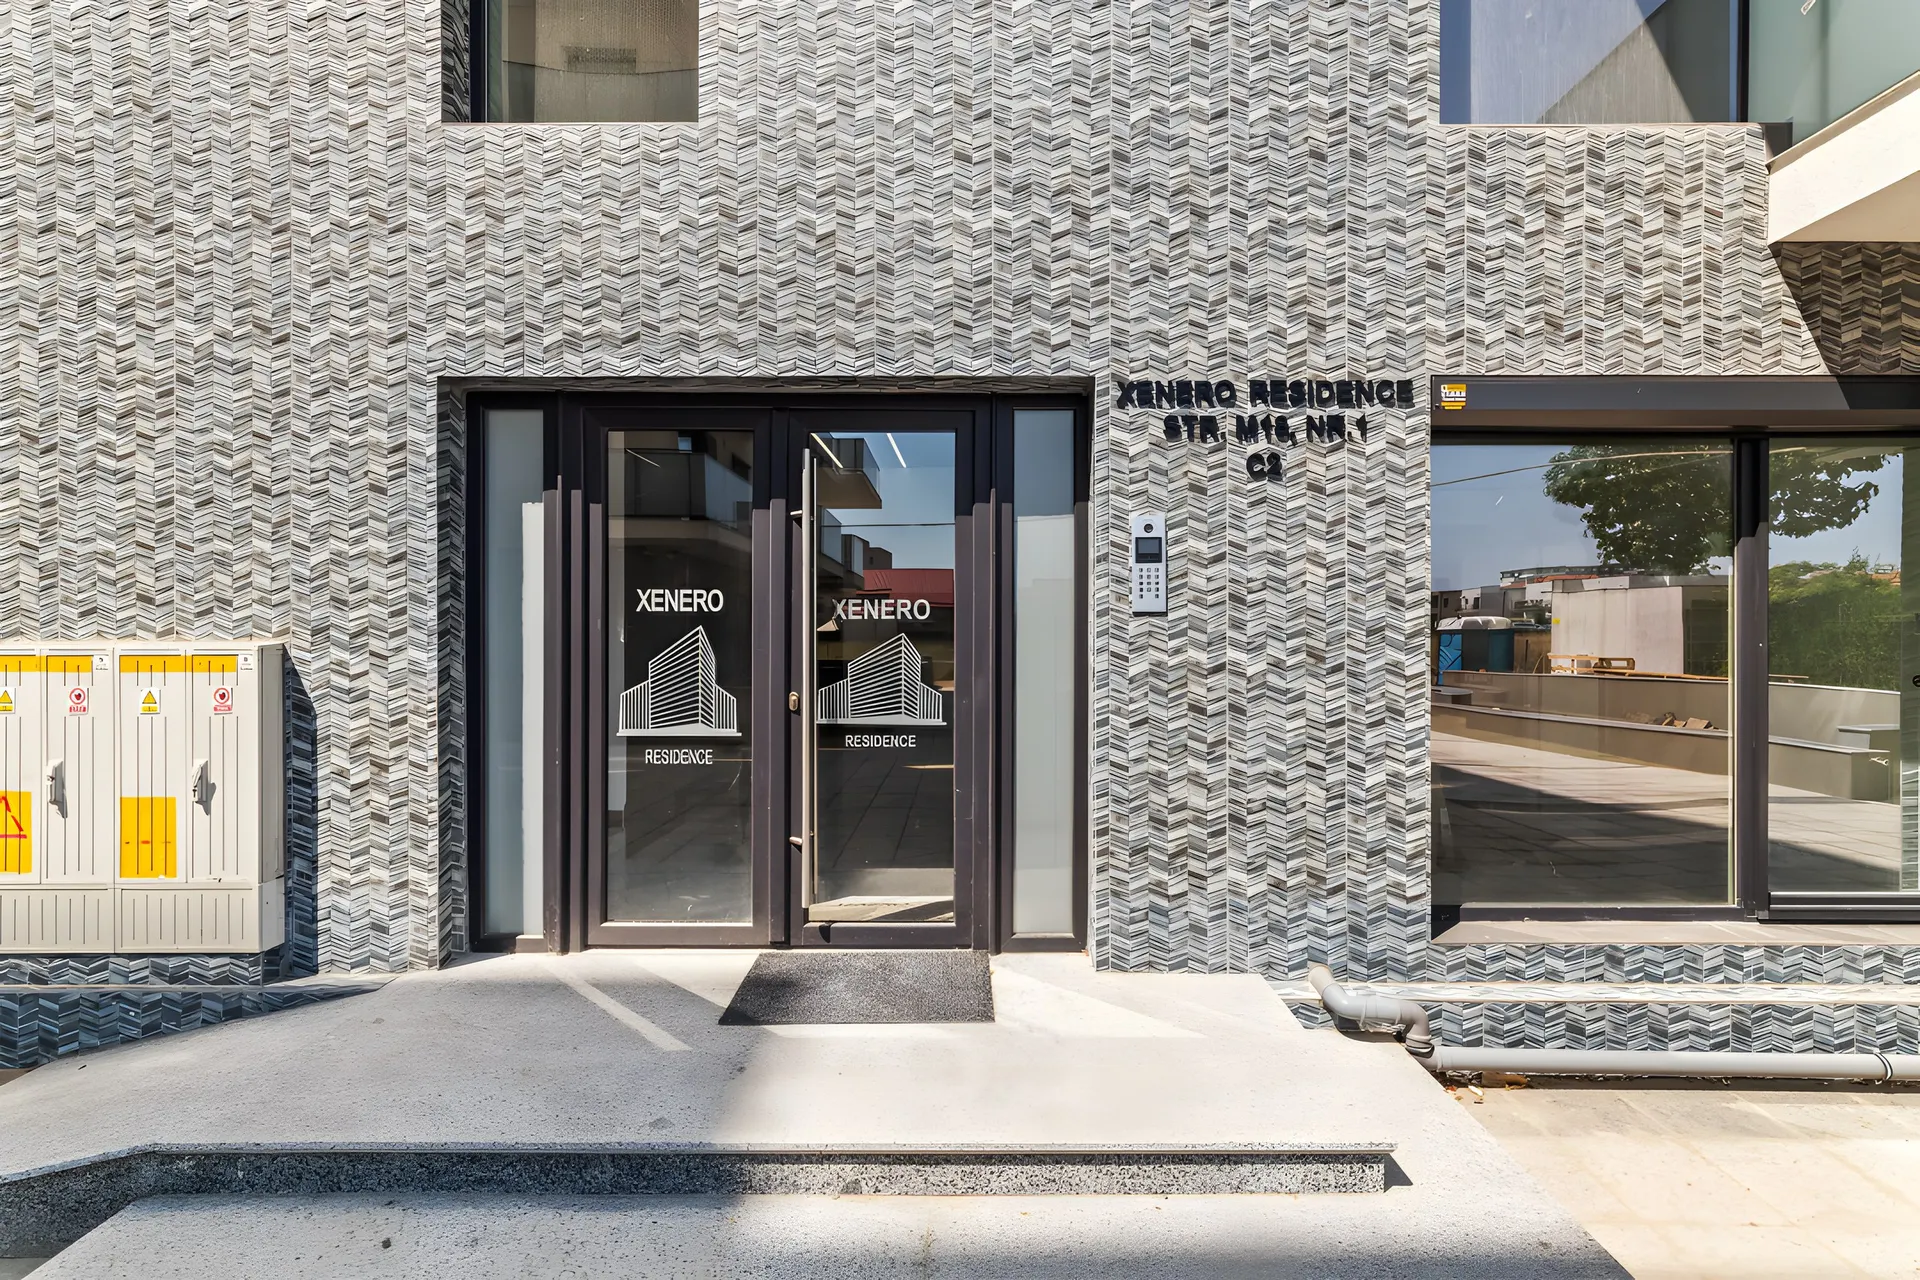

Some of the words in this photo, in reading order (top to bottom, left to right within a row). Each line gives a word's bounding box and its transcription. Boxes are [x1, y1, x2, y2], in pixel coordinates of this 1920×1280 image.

[1117, 380, 1237, 409] XENERO
[1249, 379, 1415, 409] RESIDENCE
[1246, 451, 1283, 482] C2
[636, 588, 724, 612] XENERO
[835, 598, 931, 620] XENERO
[845, 734, 916, 748] RESIDENCE
[645, 749, 713, 765] RESIDENCE
